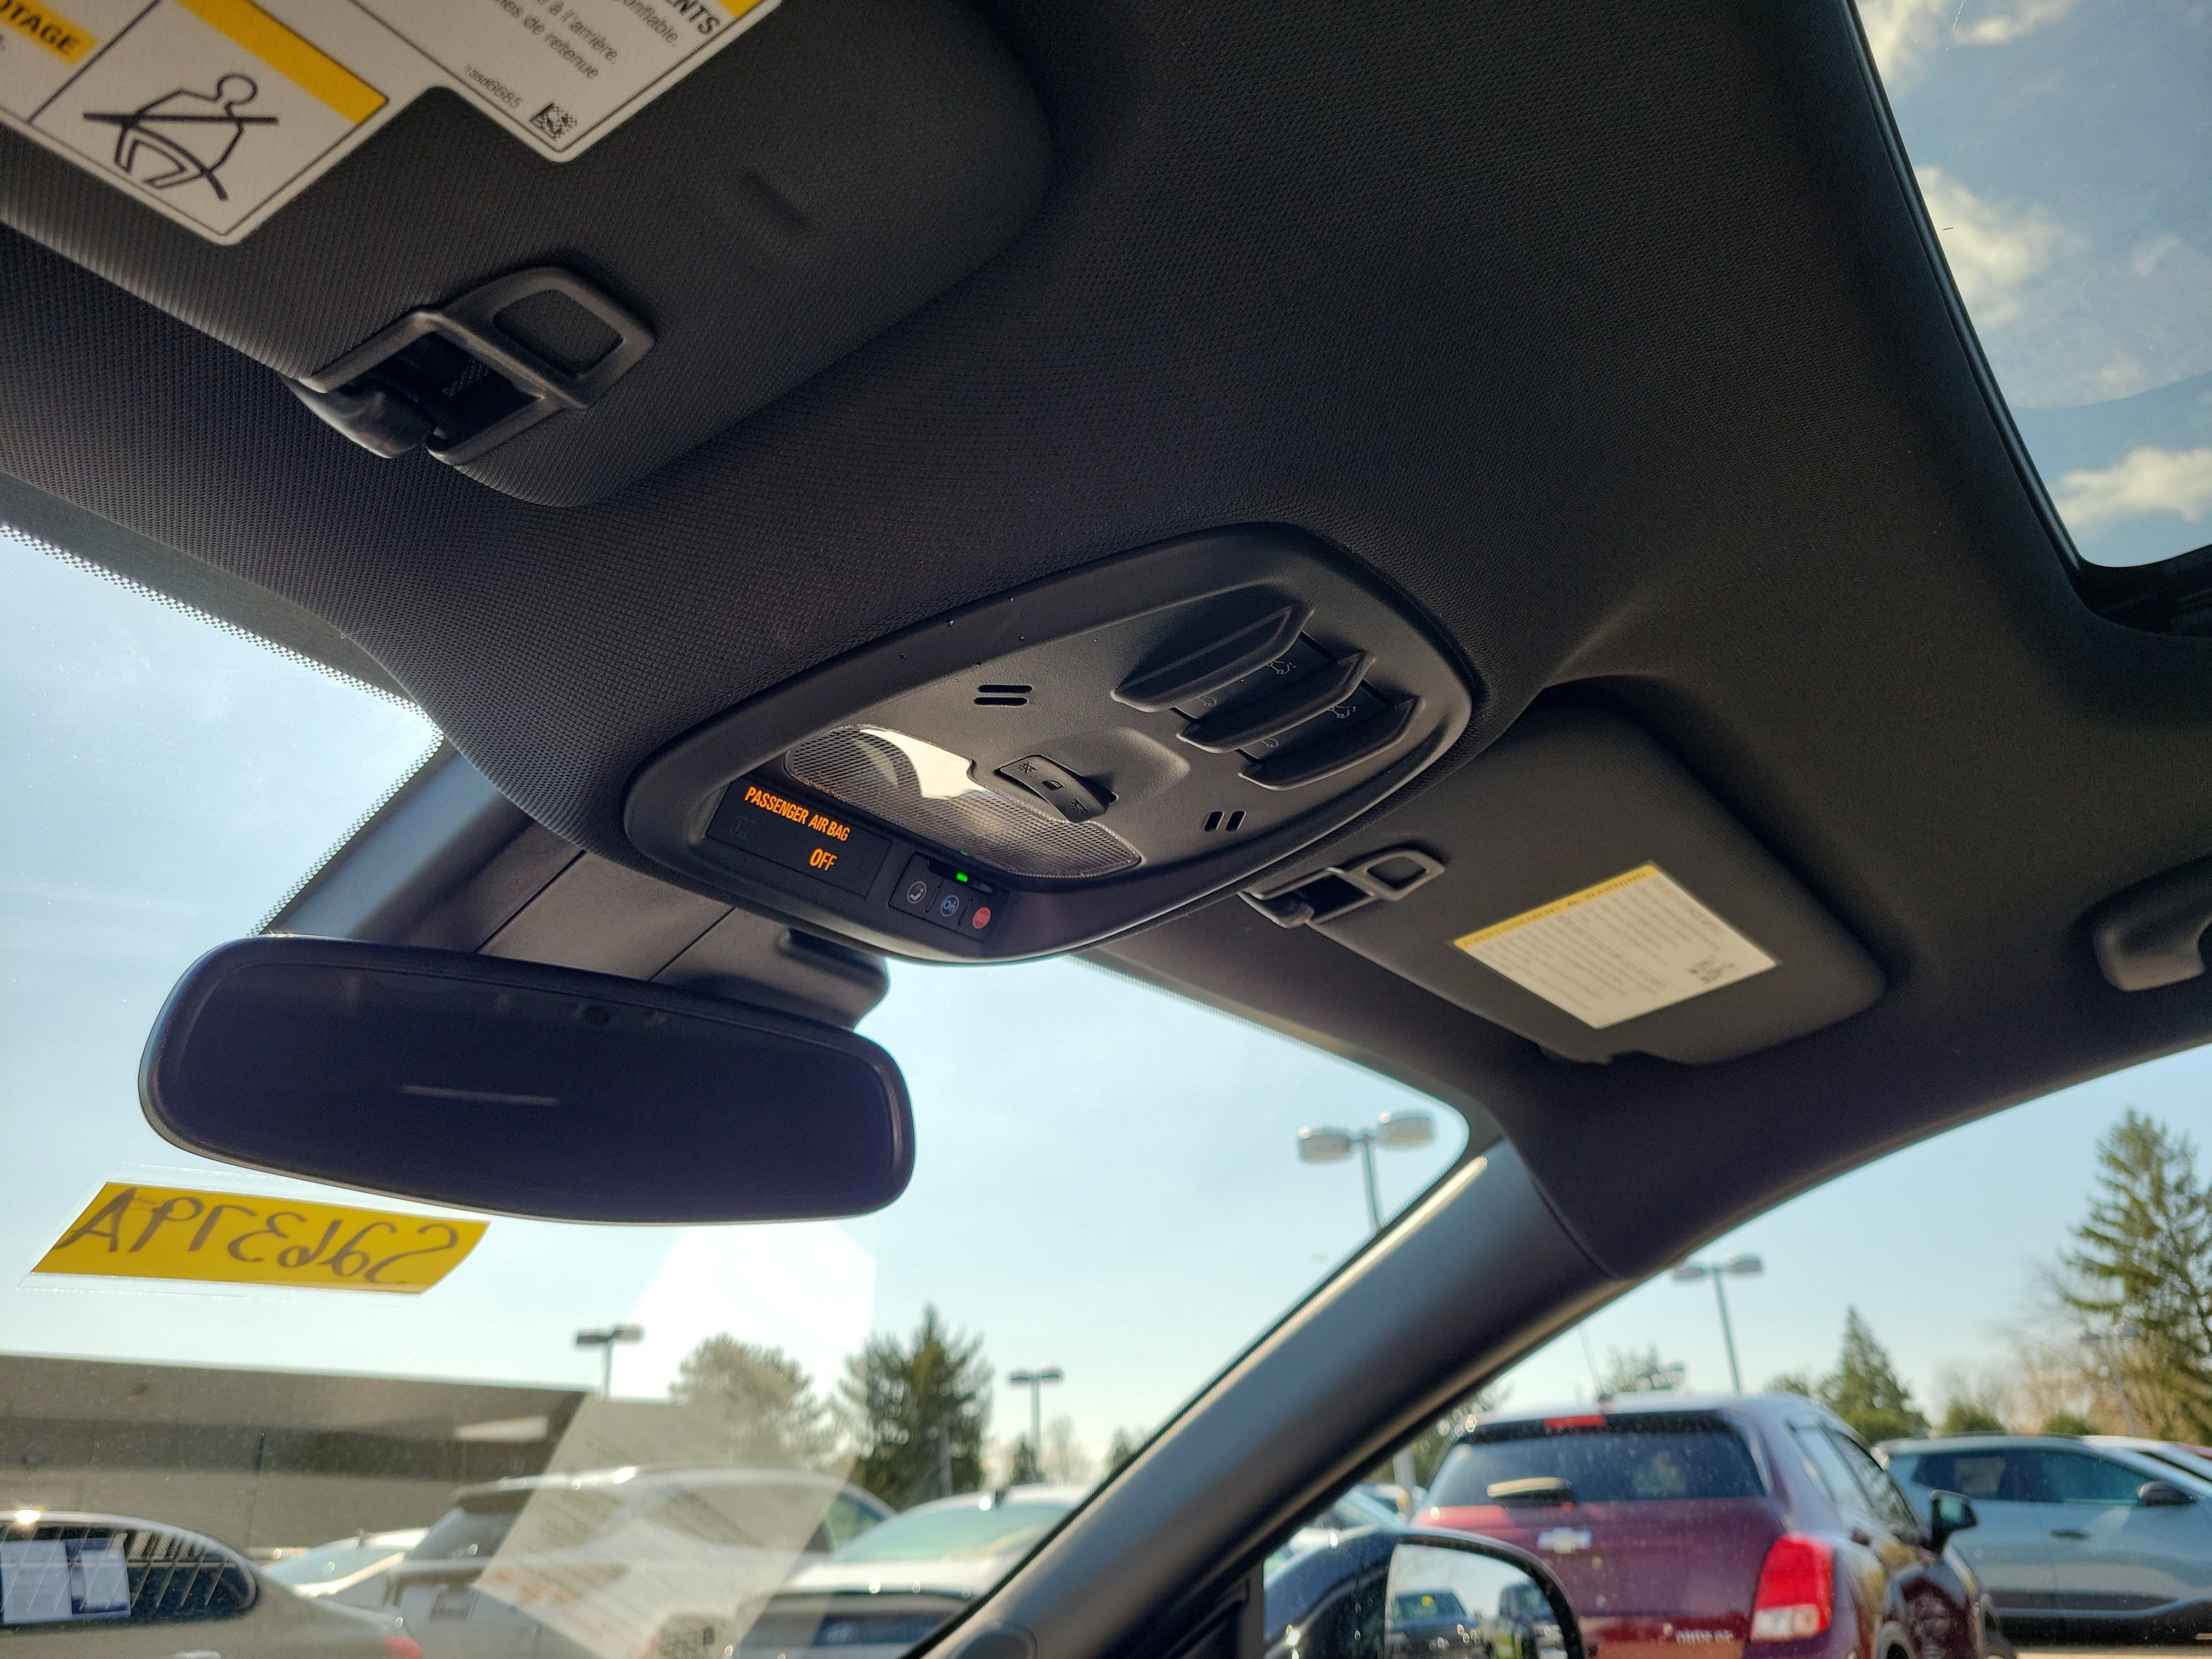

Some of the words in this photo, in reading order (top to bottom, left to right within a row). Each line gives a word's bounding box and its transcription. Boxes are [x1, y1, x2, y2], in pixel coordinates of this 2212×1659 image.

[560, 9, 618, 65] l'arrière.
[665, 0, 720, 35] NTS
[523, 14, 545, 35] de
[542, 30, 599, 79] retenue
[744, 787, 809, 824] PASSENGER
[808, 815, 828, 833] AIR
[826, 821, 850, 841] BAG
[809, 849, 837, 870] OFF
